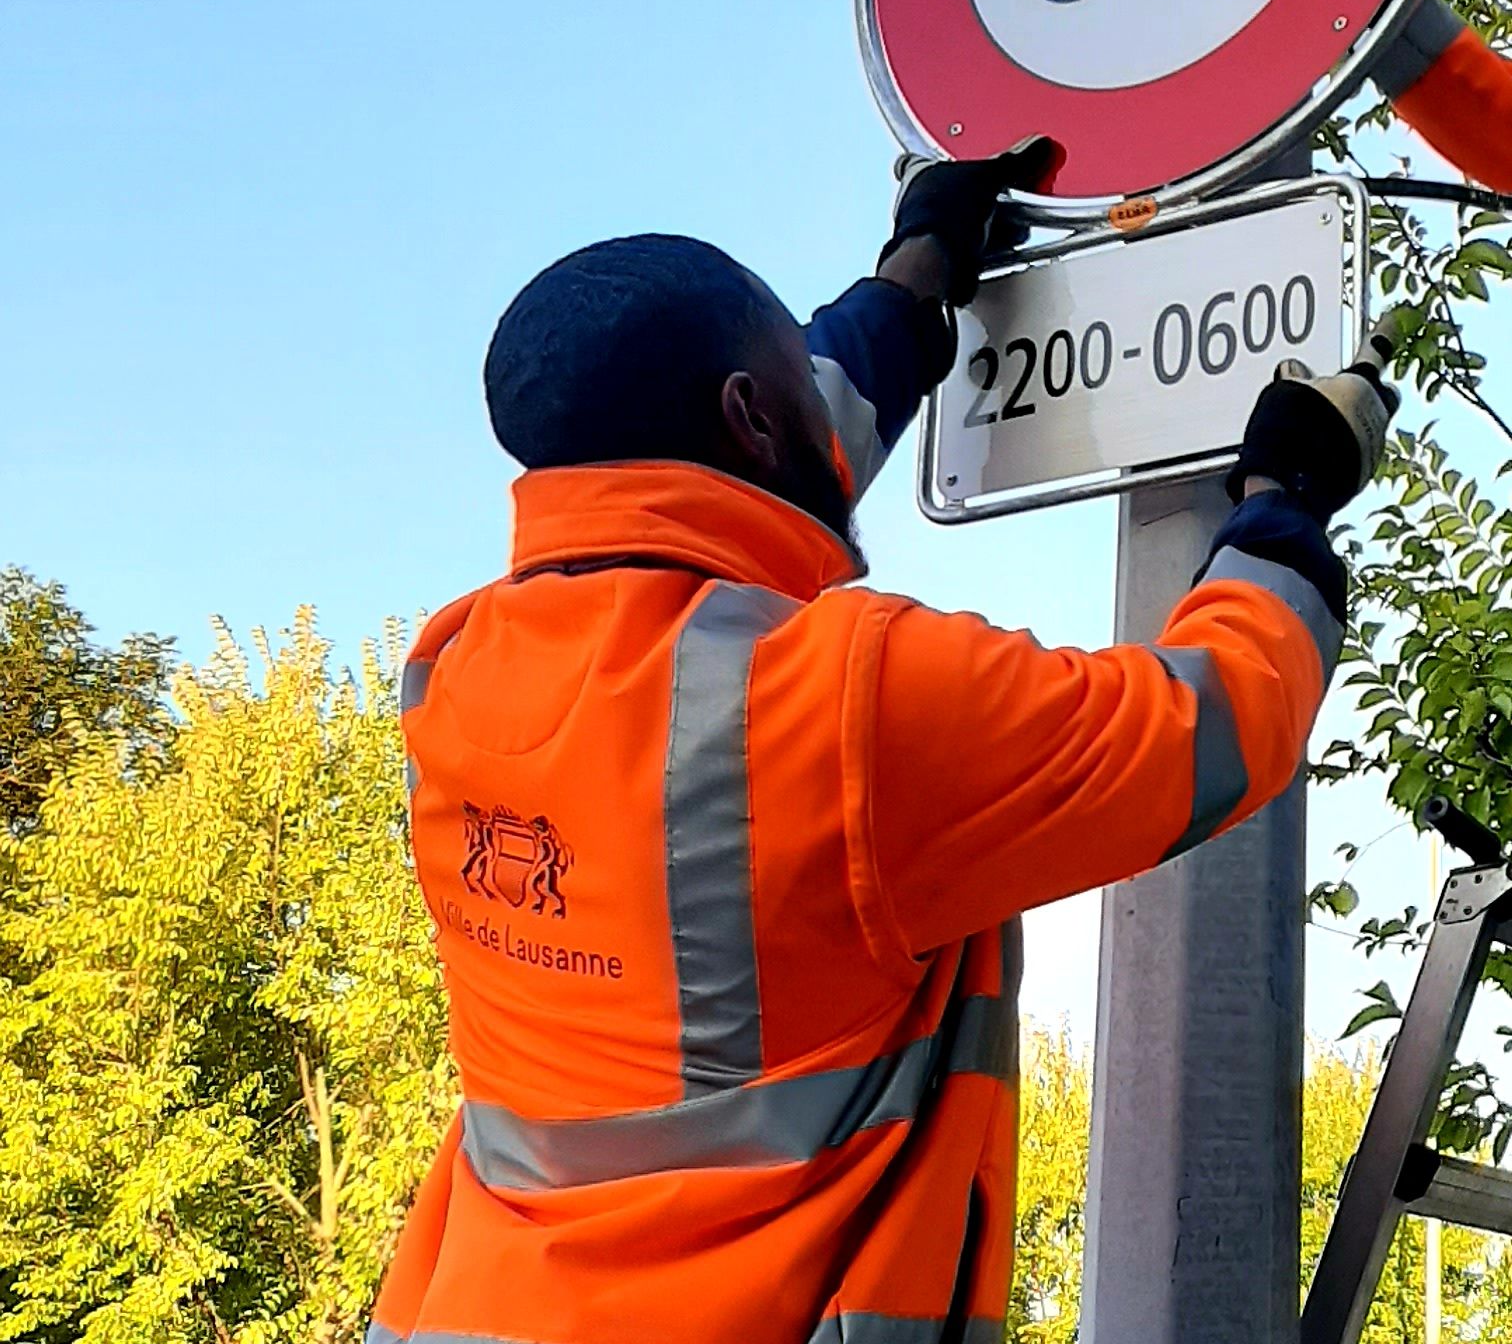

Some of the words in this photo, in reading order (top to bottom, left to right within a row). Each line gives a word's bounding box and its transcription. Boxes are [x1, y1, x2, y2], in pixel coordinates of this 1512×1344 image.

[963, 273, 1317, 430] 2200-0600
[477, 916, 500, 952] de
[505, 924, 624, 980] Lausanne
